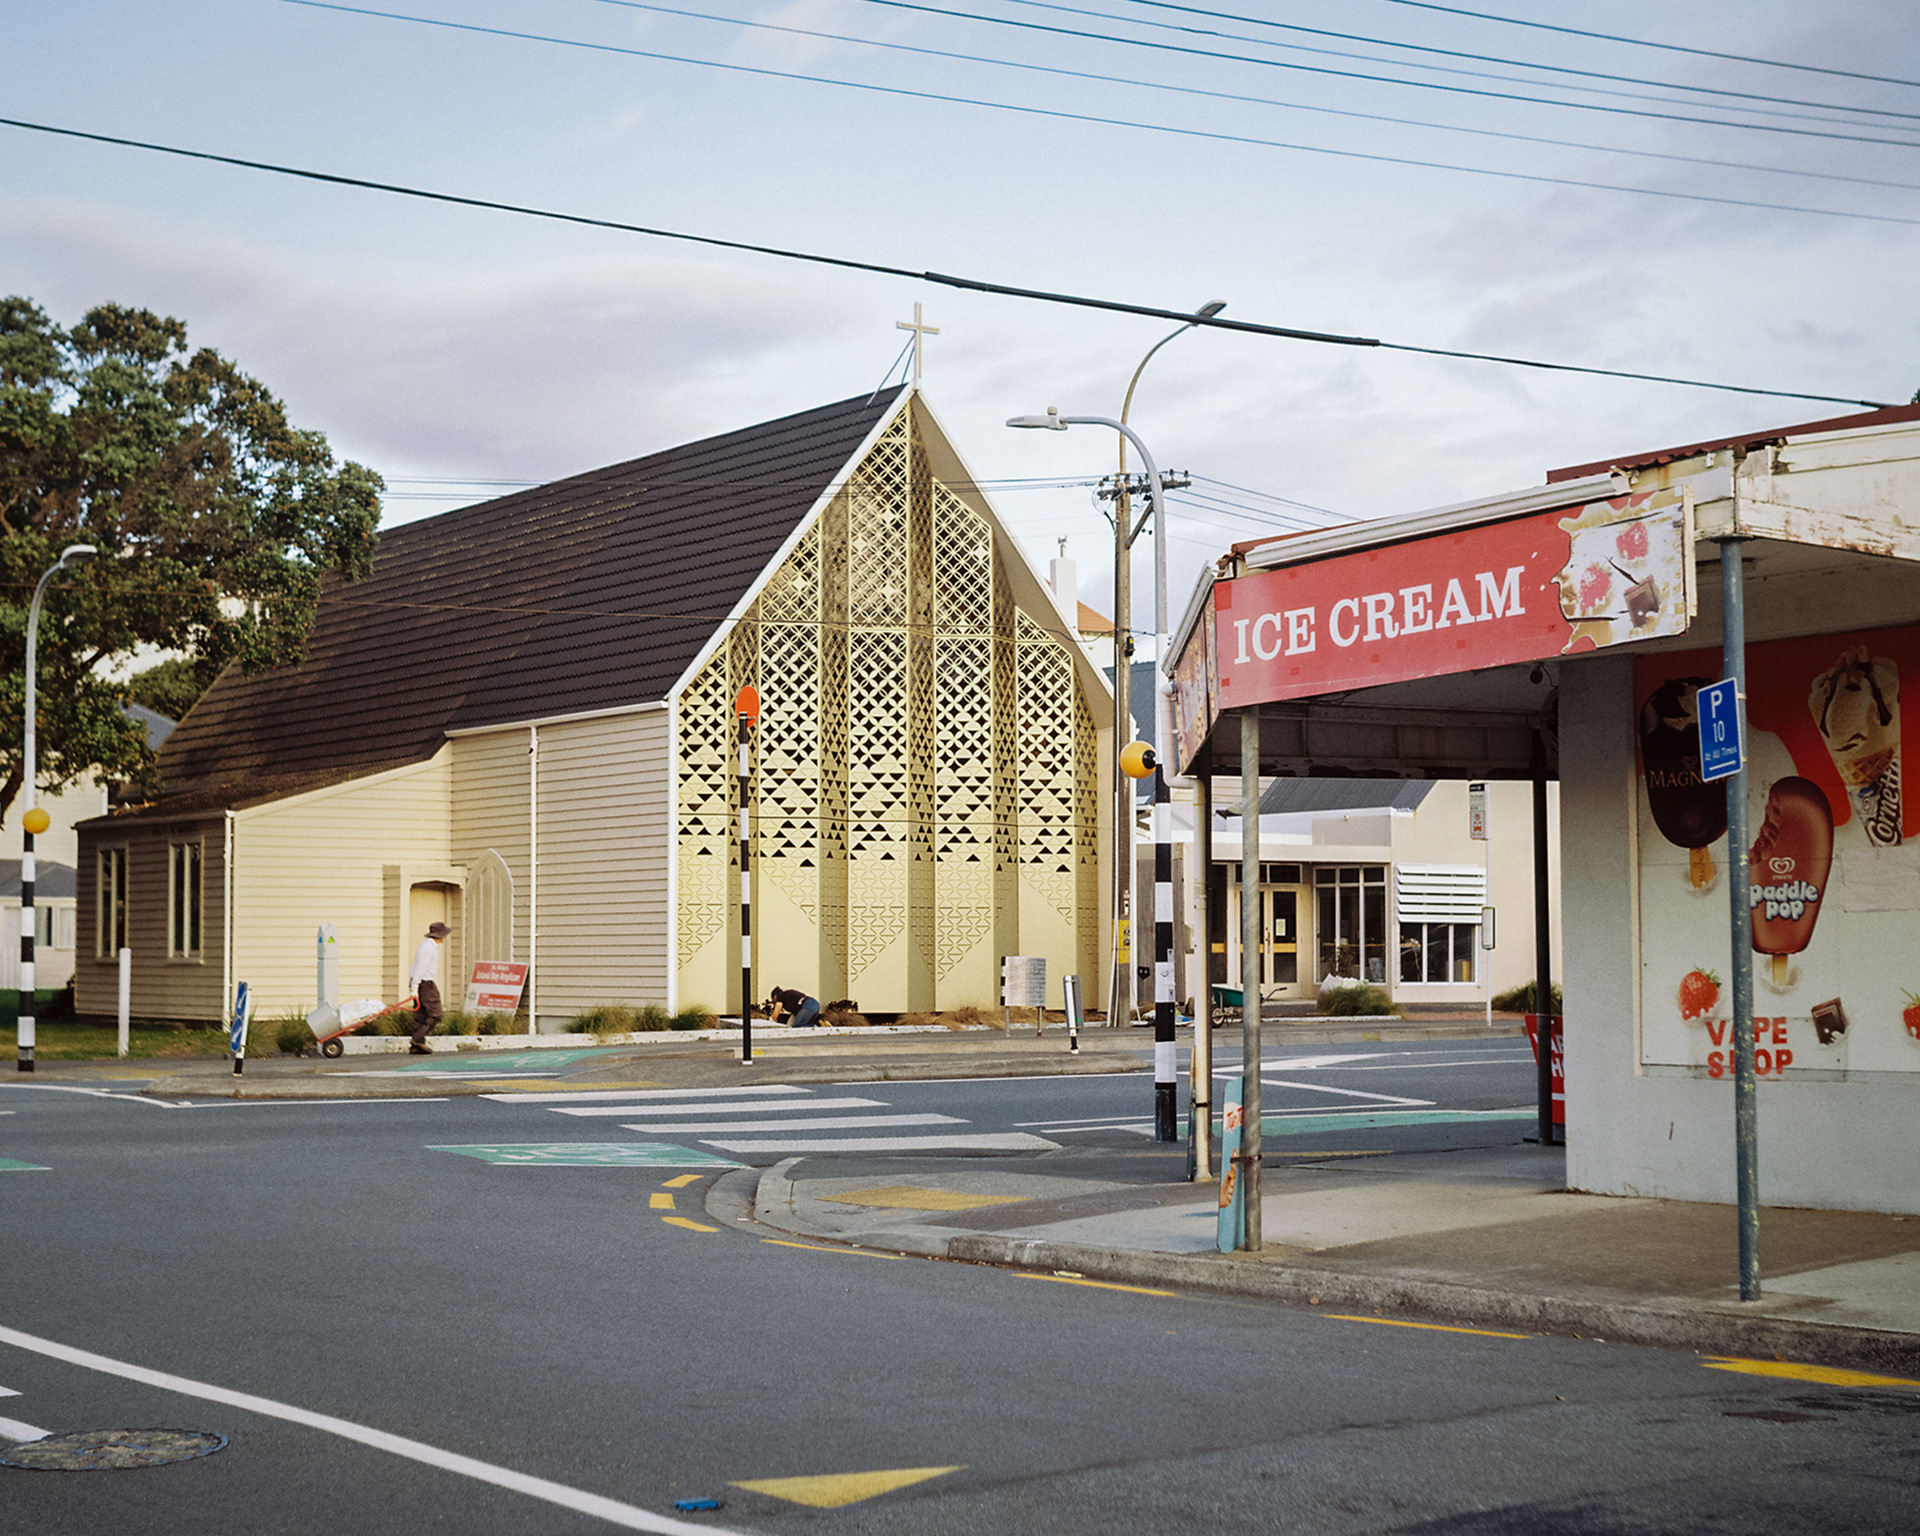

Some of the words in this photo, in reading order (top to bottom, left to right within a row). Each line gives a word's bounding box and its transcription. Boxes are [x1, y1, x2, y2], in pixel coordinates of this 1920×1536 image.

[1233, 605, 1316, 665] ICE
[1329, 565, 1526, 648] CREAM
[1710, 689, 1723, 719] P
[1713, 720, 1725, 743] 10
[1750, 880, 1818, 908] paddle
[1765, 899, 1805, 921] pop
[1705, 1017, 1788, 1046] VPE
